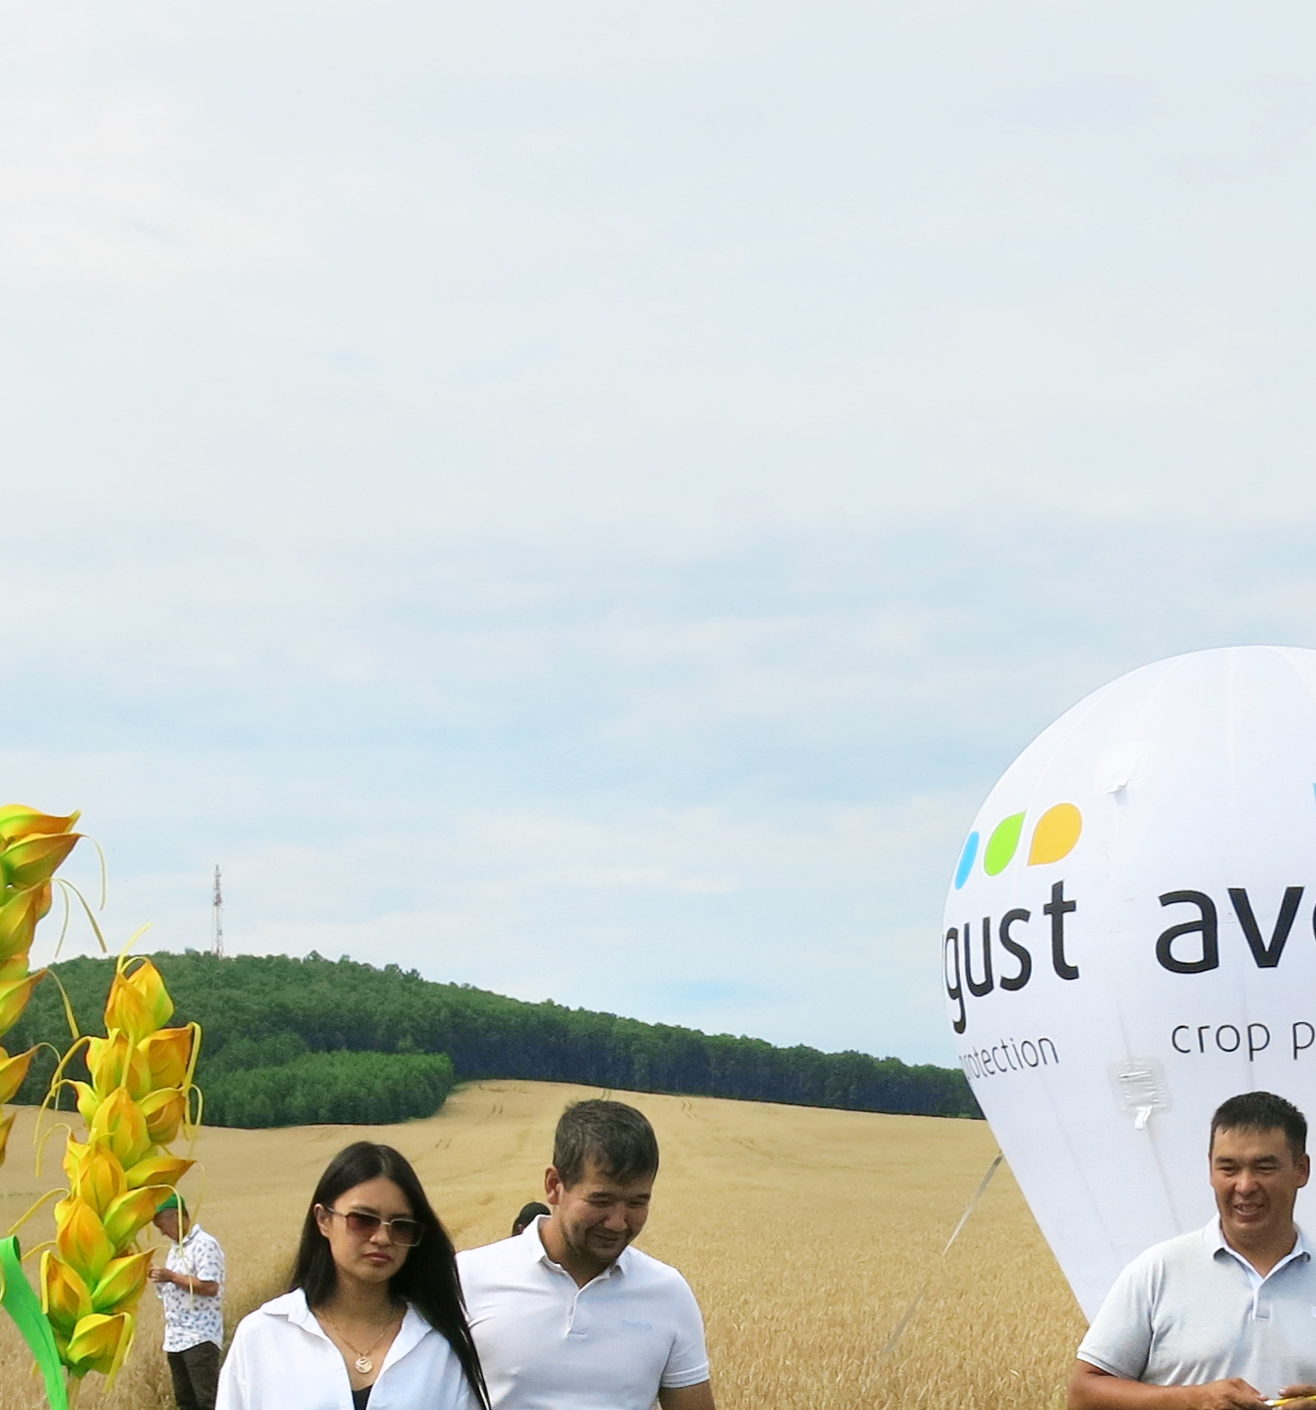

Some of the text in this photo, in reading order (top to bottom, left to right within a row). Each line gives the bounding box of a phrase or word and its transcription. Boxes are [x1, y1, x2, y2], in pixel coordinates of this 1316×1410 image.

[943, 878, 1080, 1035] gust
[959, 1036, 1059, 1081] rotection
[1171, 1021, 1271, 1061] crop
